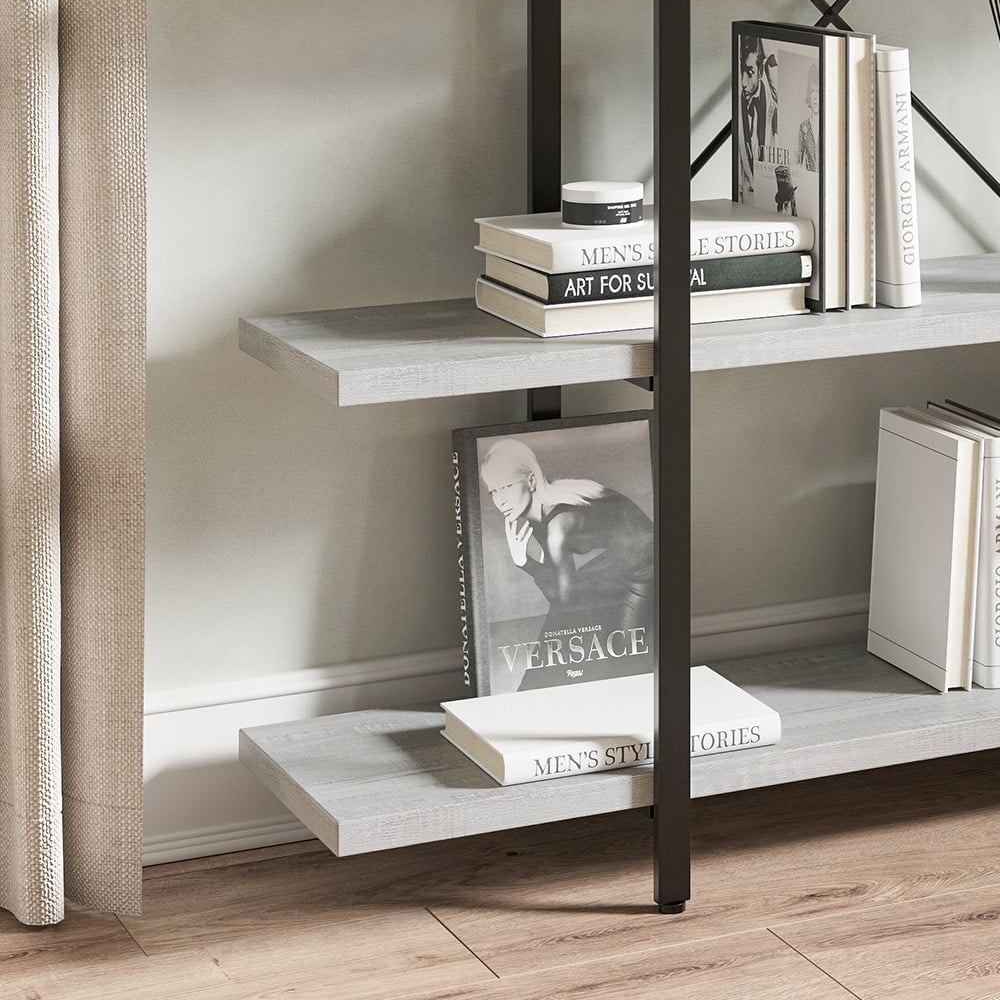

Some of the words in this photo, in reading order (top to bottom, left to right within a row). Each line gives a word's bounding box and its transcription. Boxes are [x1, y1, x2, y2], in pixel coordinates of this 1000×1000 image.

[896, 92, 911, 172] ARMANI
[899, 180, 915, 266] GIORGIO
[580, 243, 642, 267] MEN'S
[714, 230, 795, 255] STORIES
[564, 276, 595, 297] ART
[600, 273, 632, 294] FOR
[498, 627, 649, 673] VERSACE
[544, 628, 577, 638] DONATELLA
[577, 624, 602, 633] VERSACE
[533, 749, 599, 777] MEN'S
[604, 742, 654, 766] STYL
[691, 725, 761, 753] TORIES
